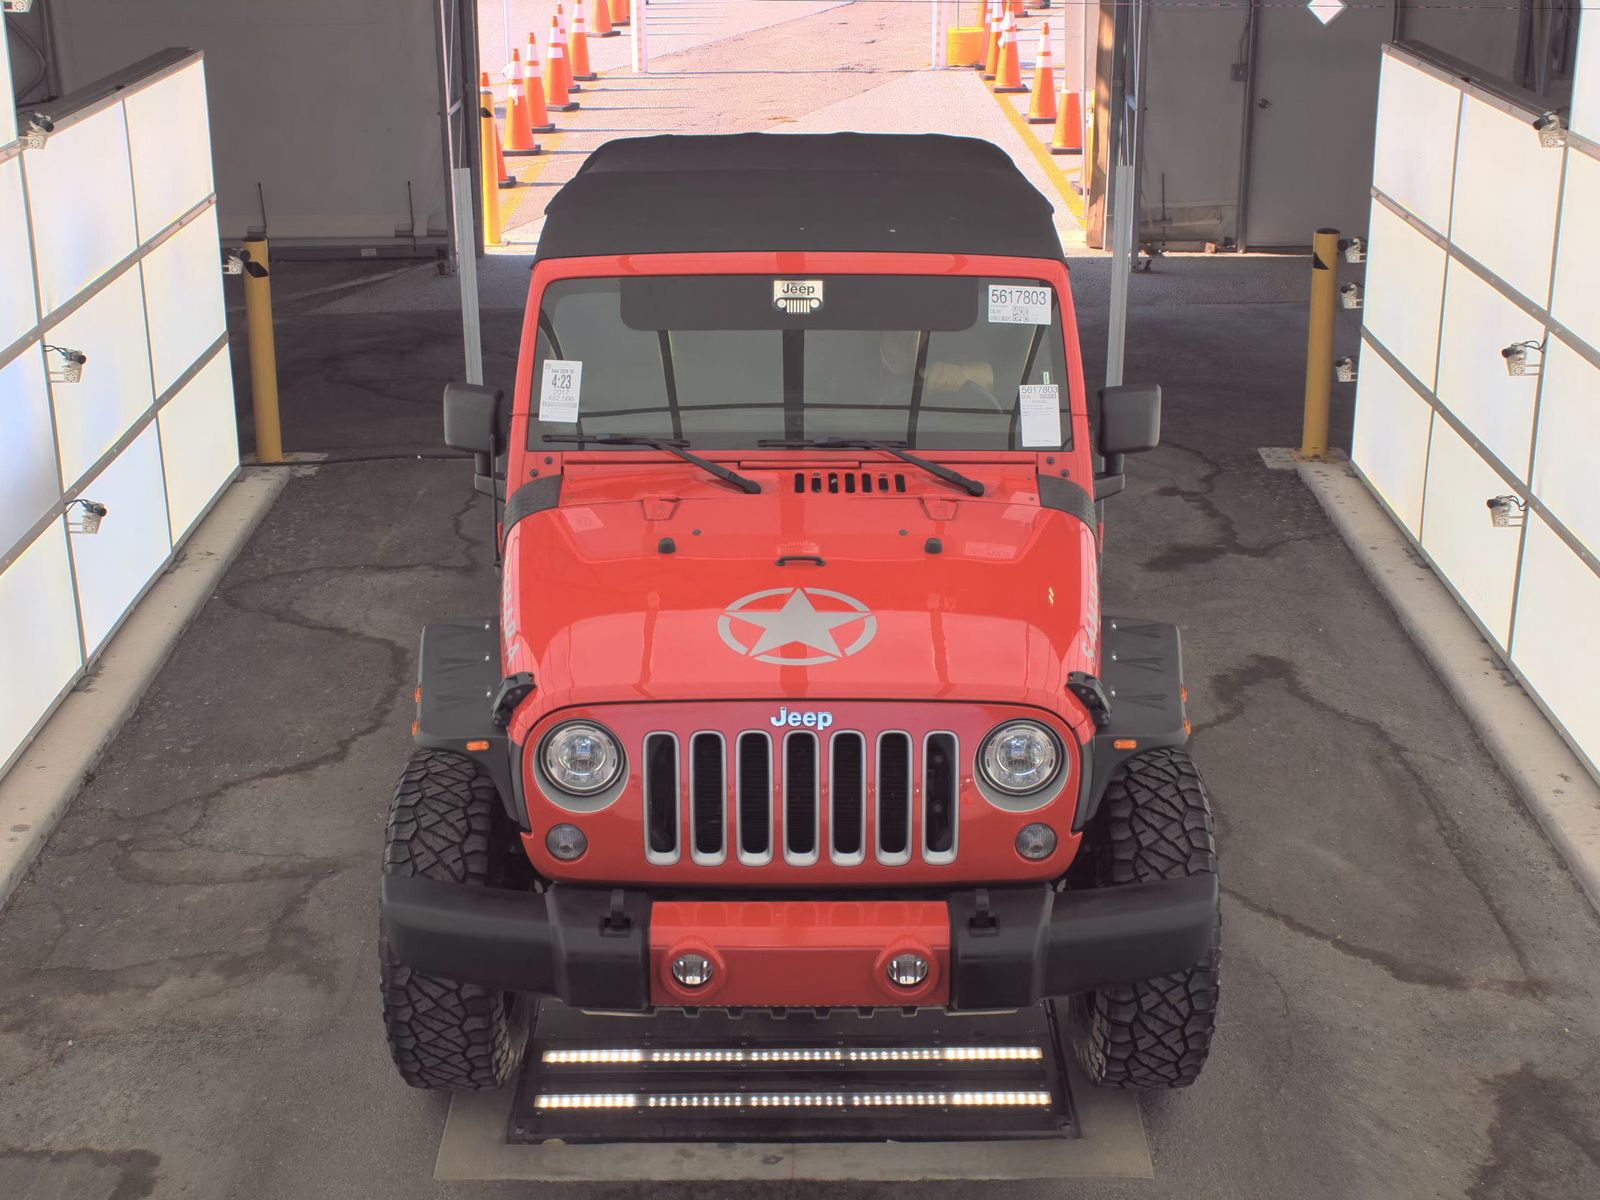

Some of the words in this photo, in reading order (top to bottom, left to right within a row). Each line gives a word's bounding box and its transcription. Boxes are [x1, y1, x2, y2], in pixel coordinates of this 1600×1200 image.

[782, 283, 815, 296] Jeep
[991, 289, 1047, 305] 5617803
[551, 374, 572, 389] 4:23
[1021, 385, 1059, 394] 5617803
[770, 706, 833, 731] Jeep
